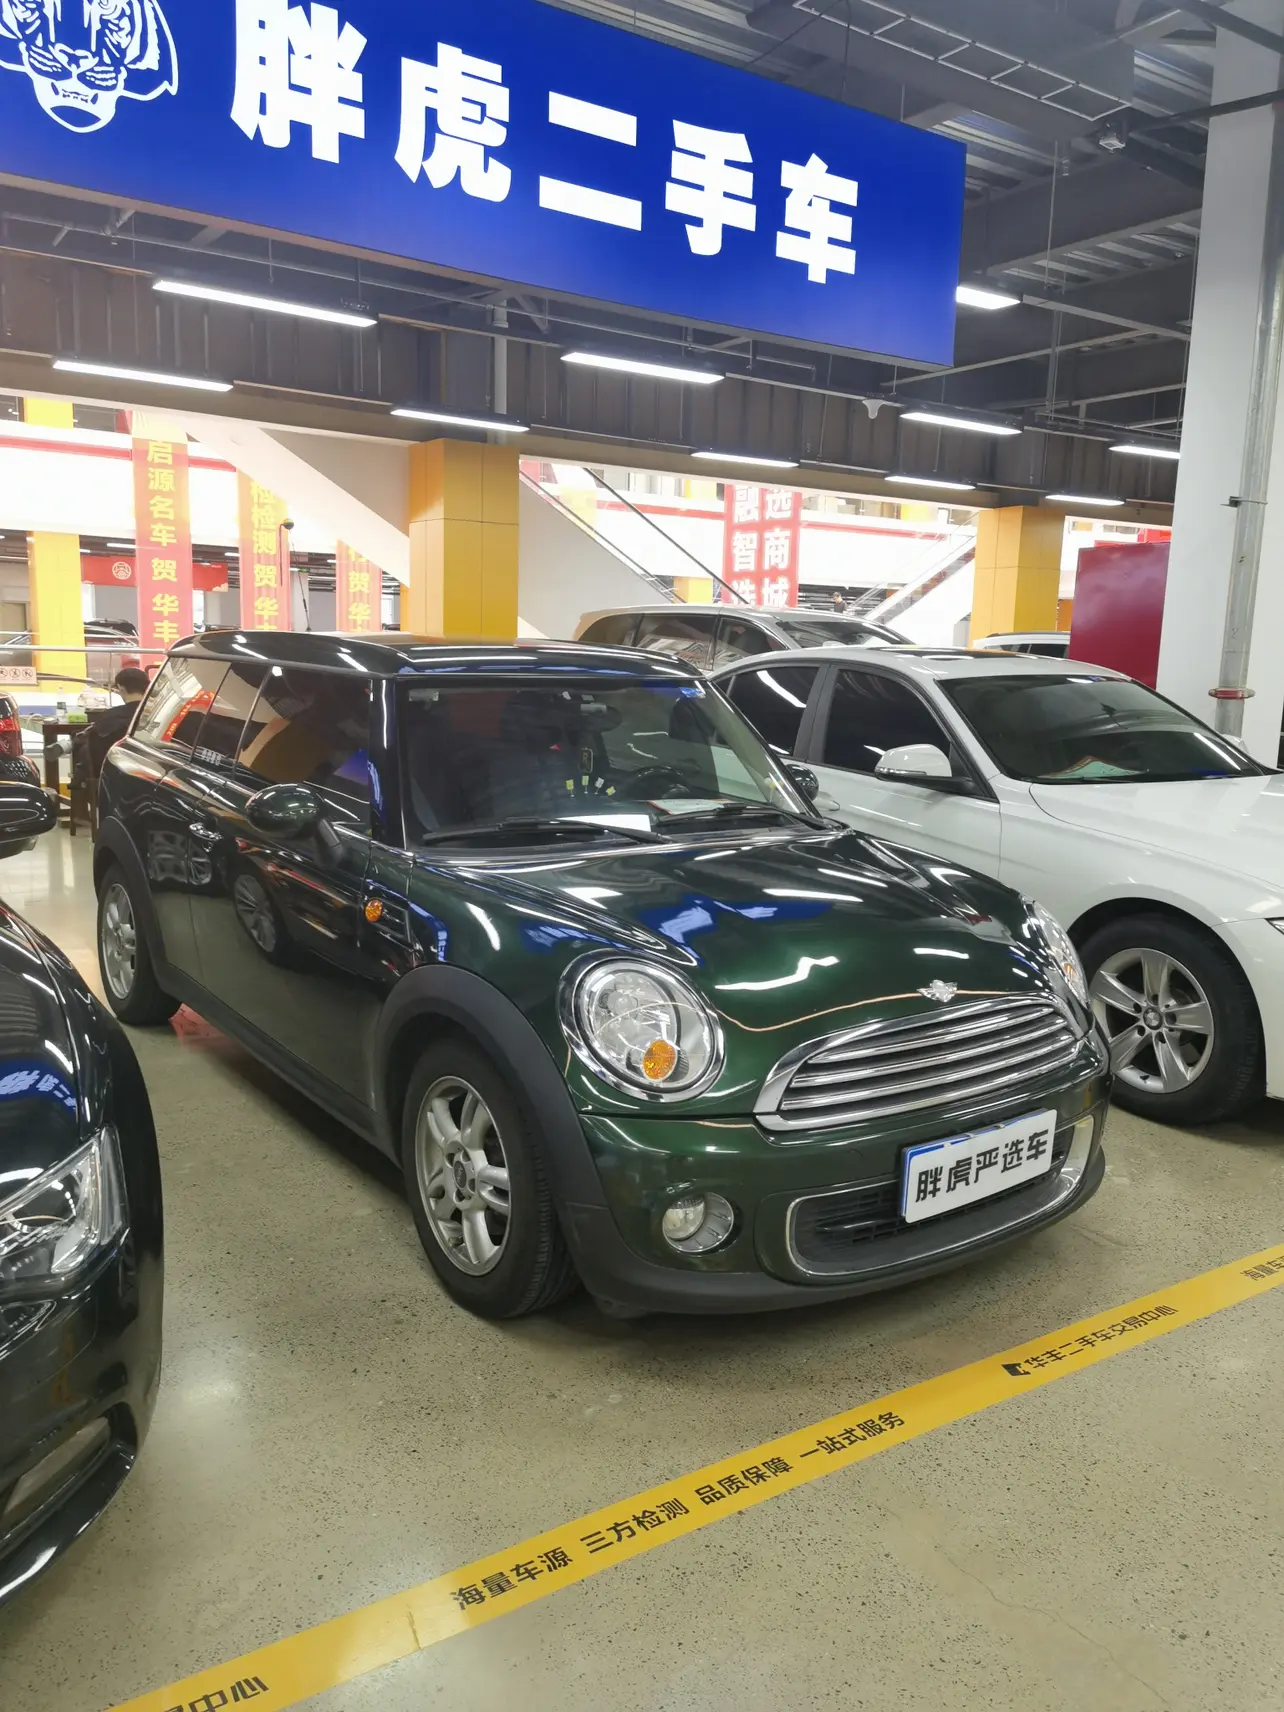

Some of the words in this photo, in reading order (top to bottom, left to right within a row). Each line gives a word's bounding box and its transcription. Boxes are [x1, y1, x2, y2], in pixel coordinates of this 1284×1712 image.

[230, 0, 859, 284] 胖虎二手车
[146, 440, 178, 547] 启源名车
[151, 557, 178, 583] 贺
[253, 564, 278, 588] 贺
[347, 570, 371, 594] 贺
[347, 602, 372, 631] 华
[915, 1128, 1050, 1203] 胖虎严选车
[1239, 1255, 1284, 1282] 海量车
[1023, 1304, 1180, 1370] 华丰二手车交易中心
[450, 1546, 574, 1612] 海量车源
[580, 1498, 690, 1554] 三方检测
[695, 1457, 794, 1507] 品质保障
[799, 1411, 906, 1460] 一站式服务
[164, 1676, 270, 1712] 中心
